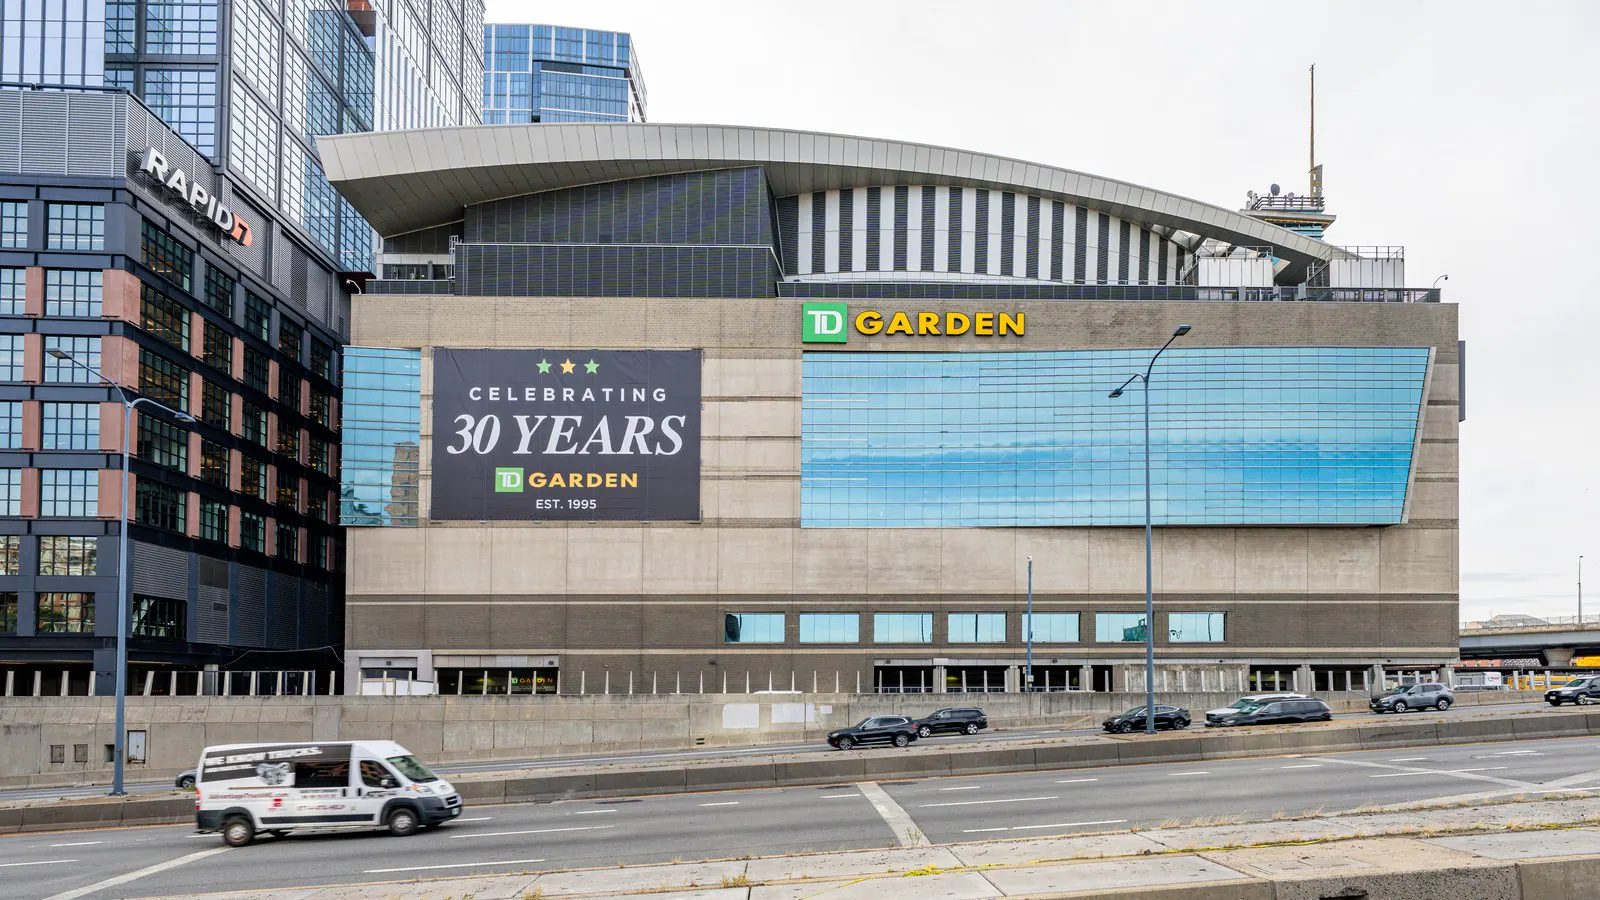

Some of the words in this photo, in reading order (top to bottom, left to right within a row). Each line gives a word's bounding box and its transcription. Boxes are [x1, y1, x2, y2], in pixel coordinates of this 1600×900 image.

[141, 146, 252, 247] RAPID7
[807, 310, 843, 335] TD
[855, 310, 1025, 336] GARDEN
[469, 386, 667, 402] CELEBRATING
[446, 414, 500, 455] 30
[512, 414, 686, 456] YEARS
[498, 472, 520, 488] TD
[528, 472, 638, 488] GARDEN
[535, 499, 563, 509] EST.
[567, 499, 597, 509] 1995
